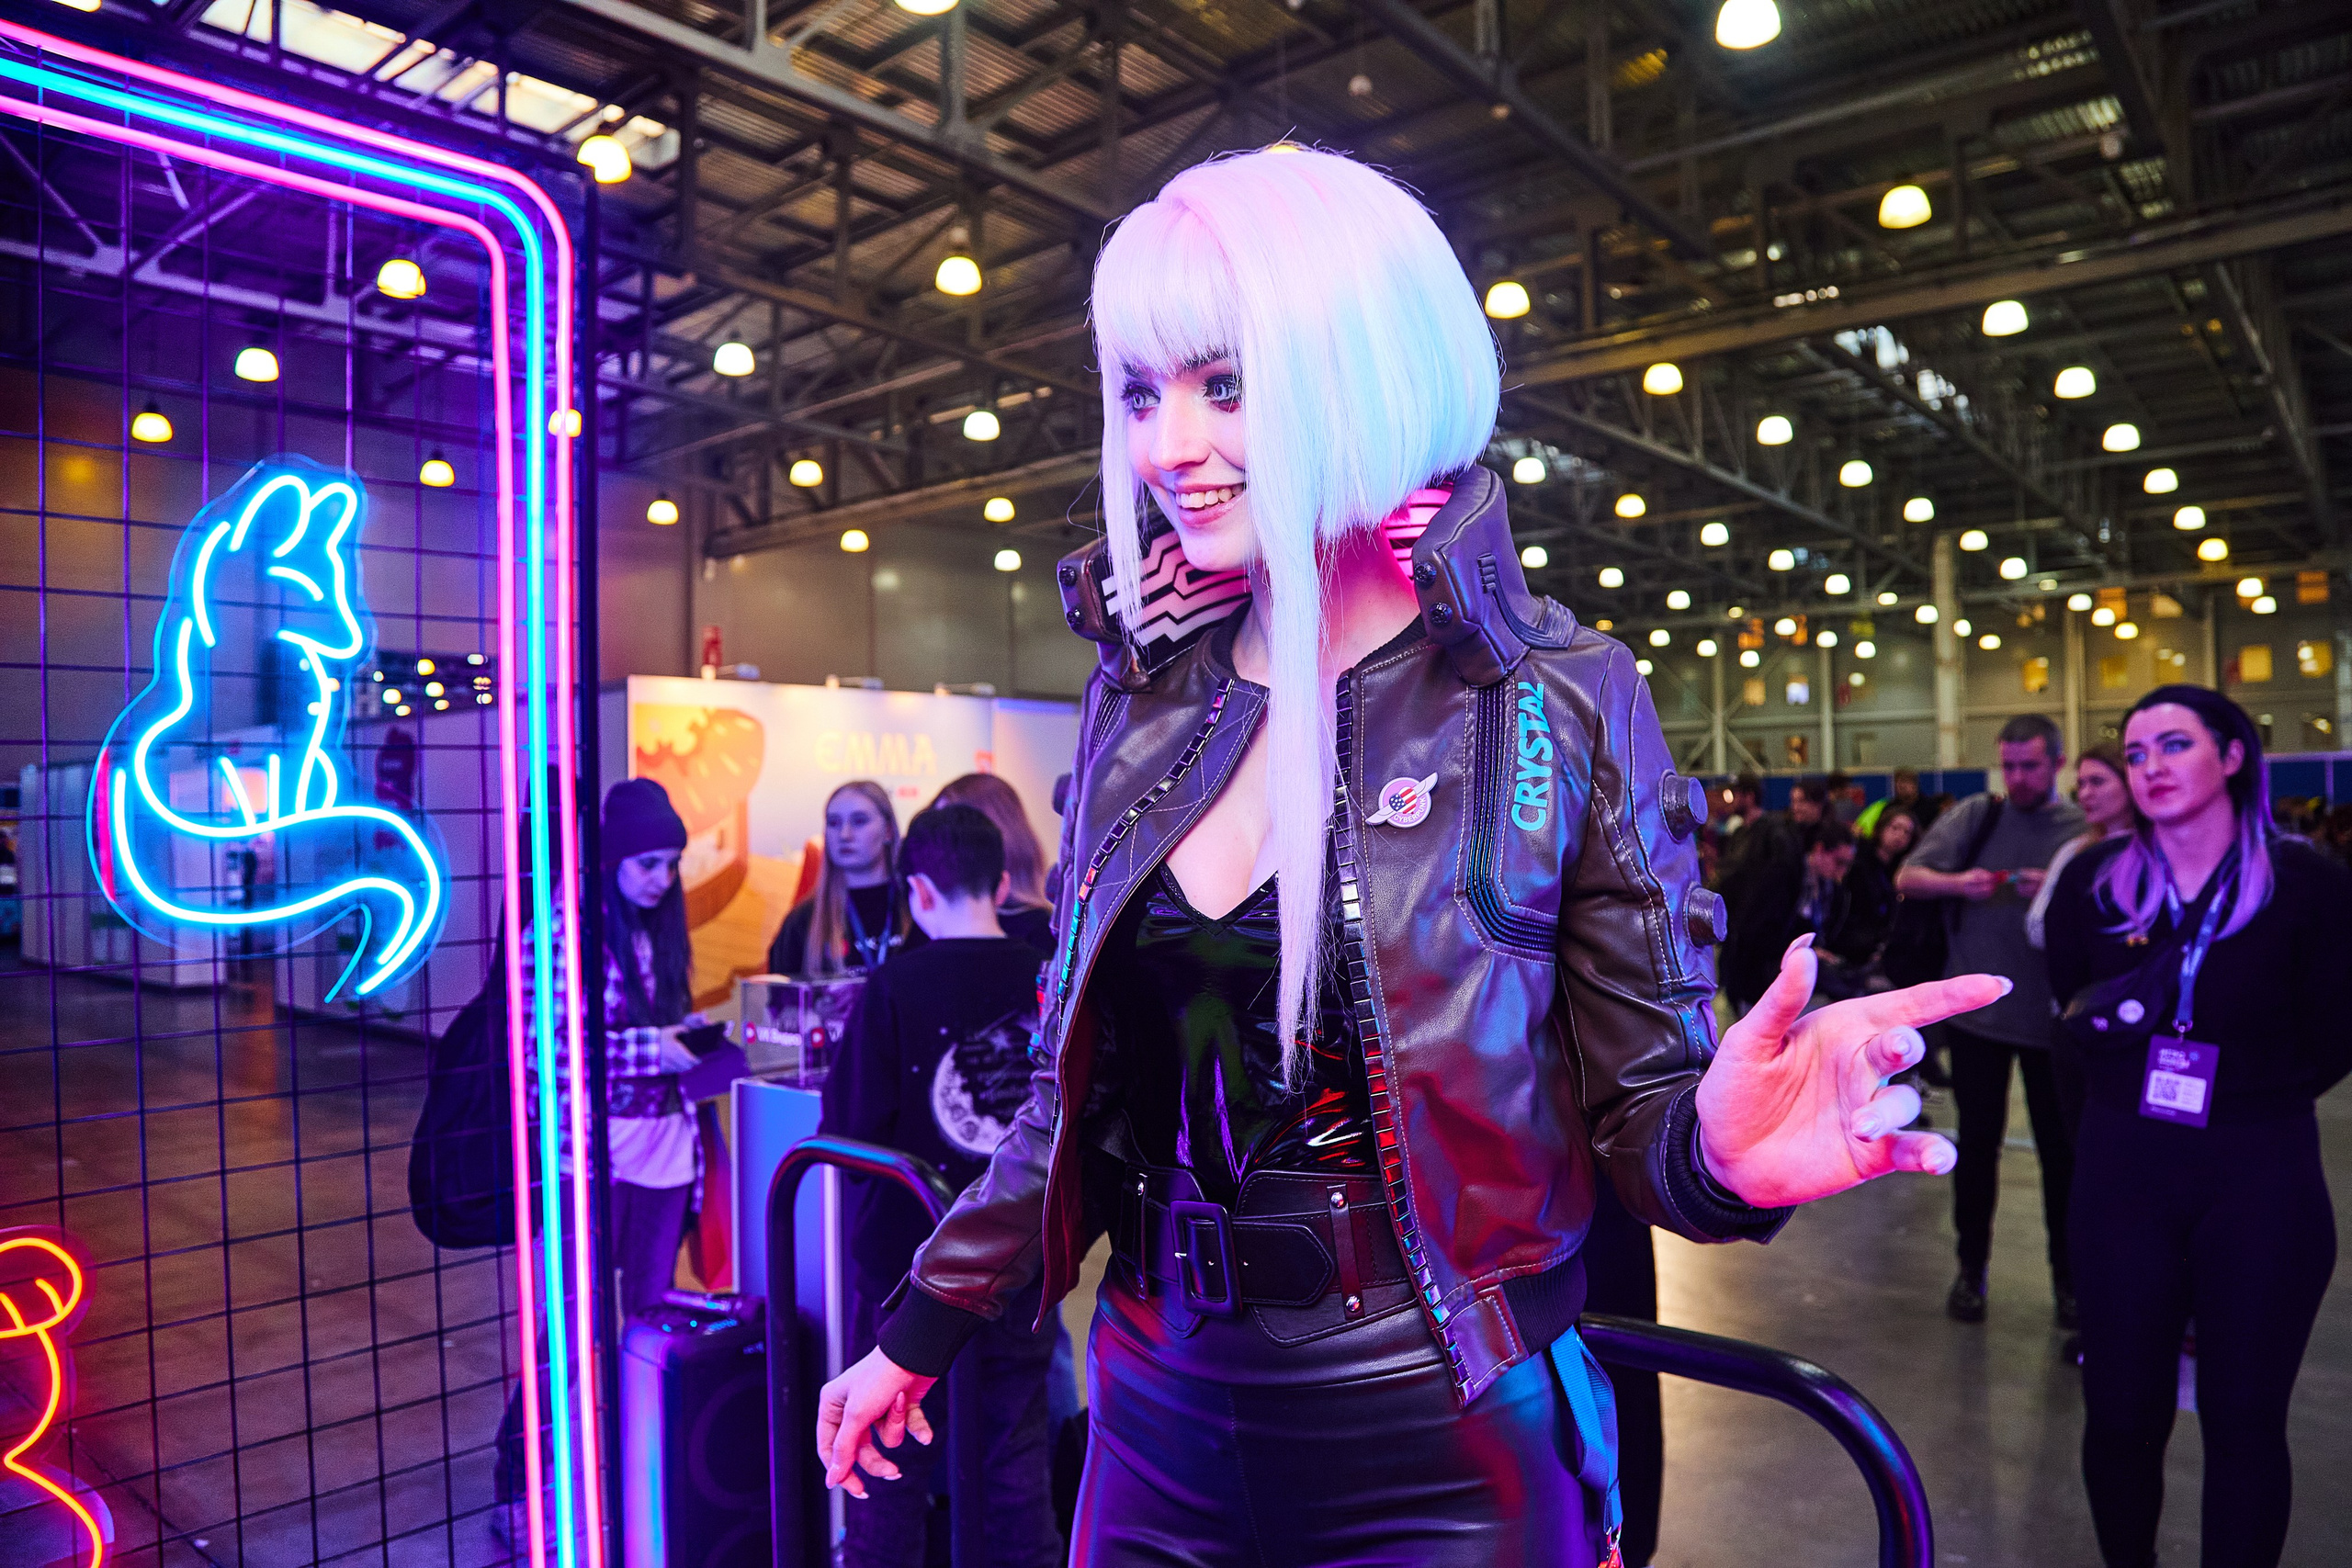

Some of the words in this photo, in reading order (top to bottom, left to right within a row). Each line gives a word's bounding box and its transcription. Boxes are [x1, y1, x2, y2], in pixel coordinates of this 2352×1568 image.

[815, 730, 937, 776] EMMA
[1511, 682, 1554, 831] CRYSTAL
[1394, 797, 1426, 823] CYBERPUNK
